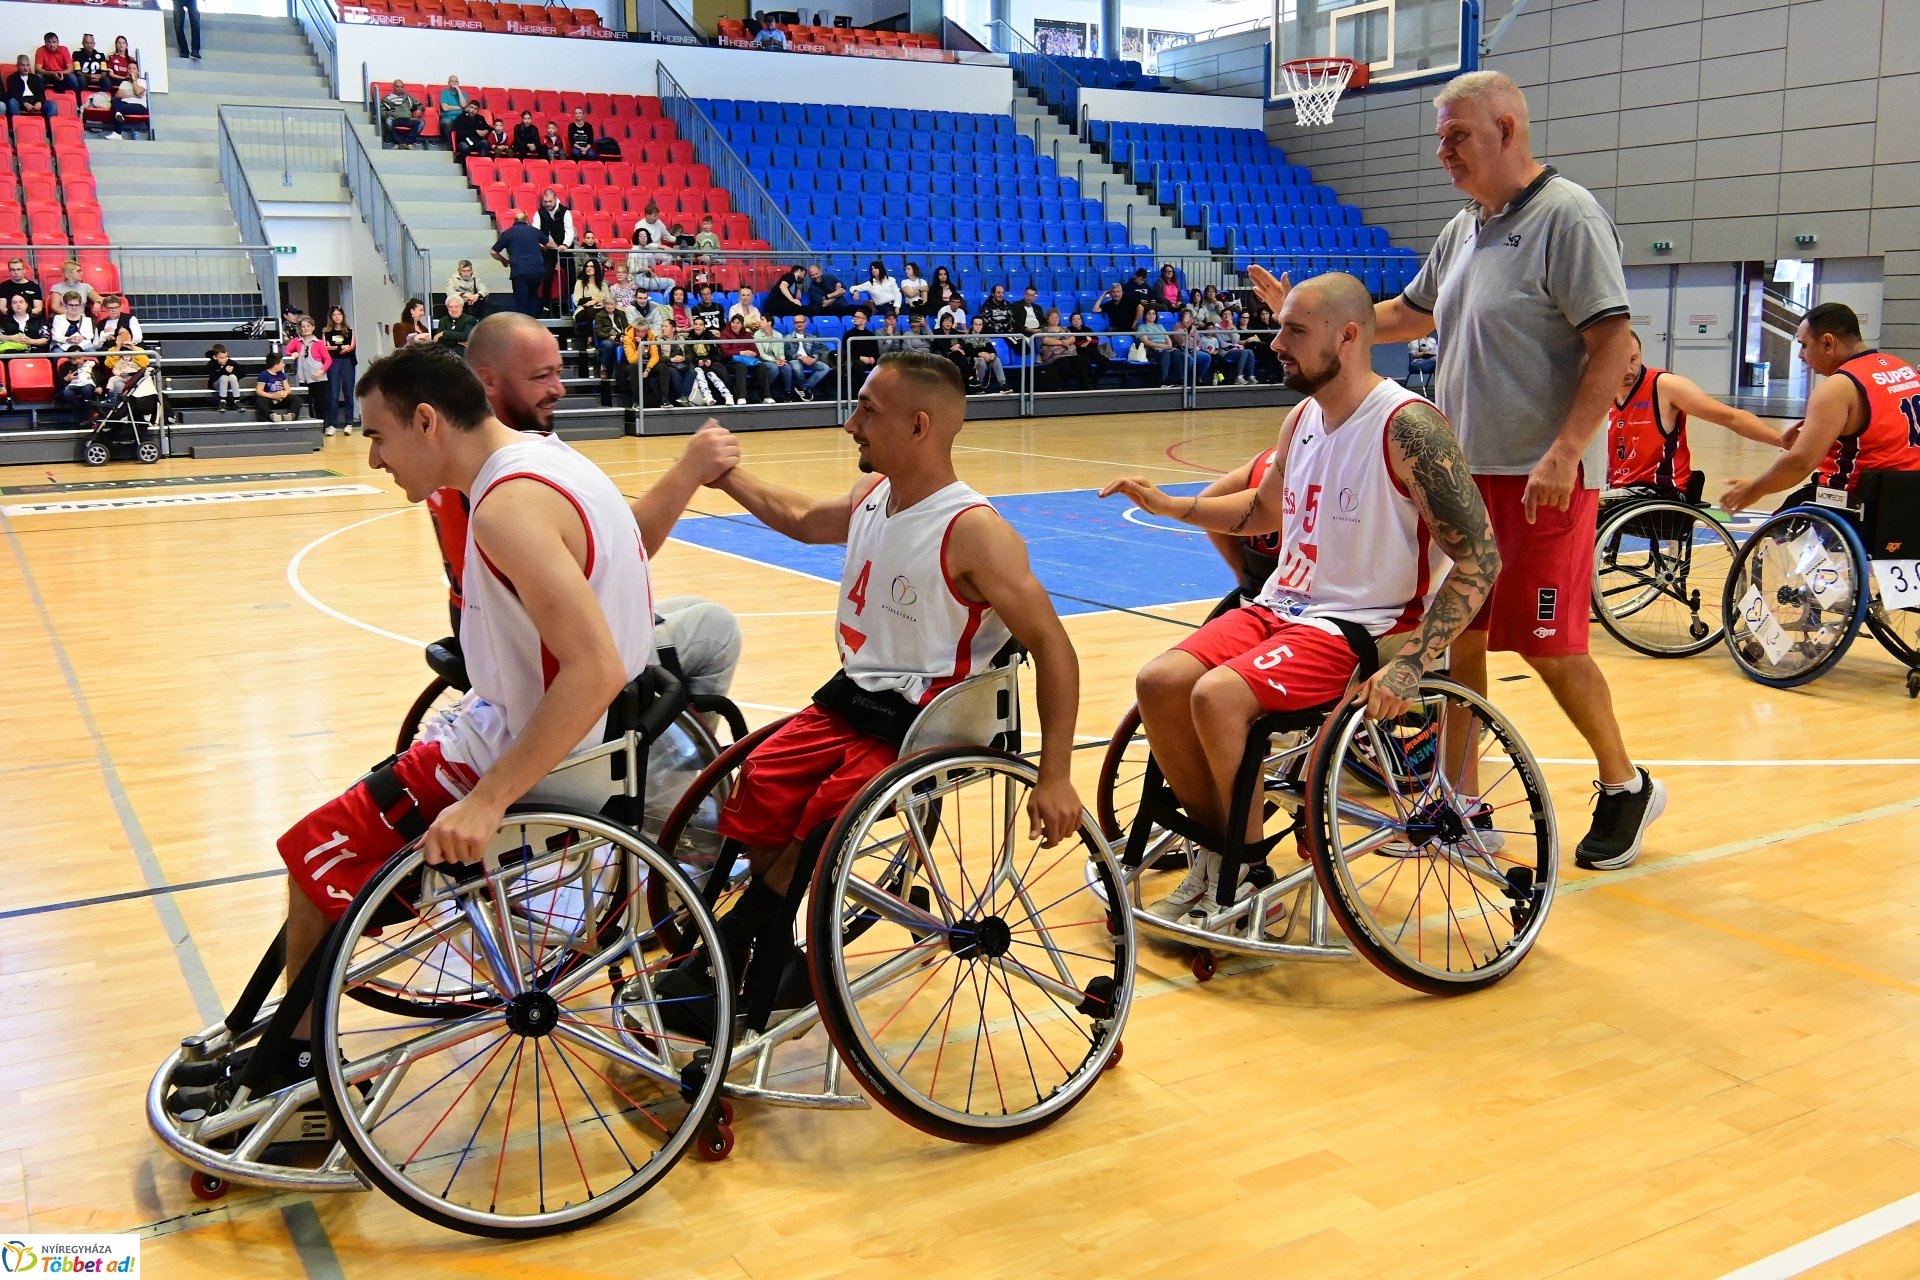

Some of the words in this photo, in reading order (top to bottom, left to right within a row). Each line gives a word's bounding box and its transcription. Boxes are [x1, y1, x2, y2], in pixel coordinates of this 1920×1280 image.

[1871, 366, 1917, 386] SUPER
[1303, 484, 1323, 534] 5
[847, 559, 873, 617] 4
[1253, 644, 1295, 670] 5
[303, 829, 358, 881] 11
